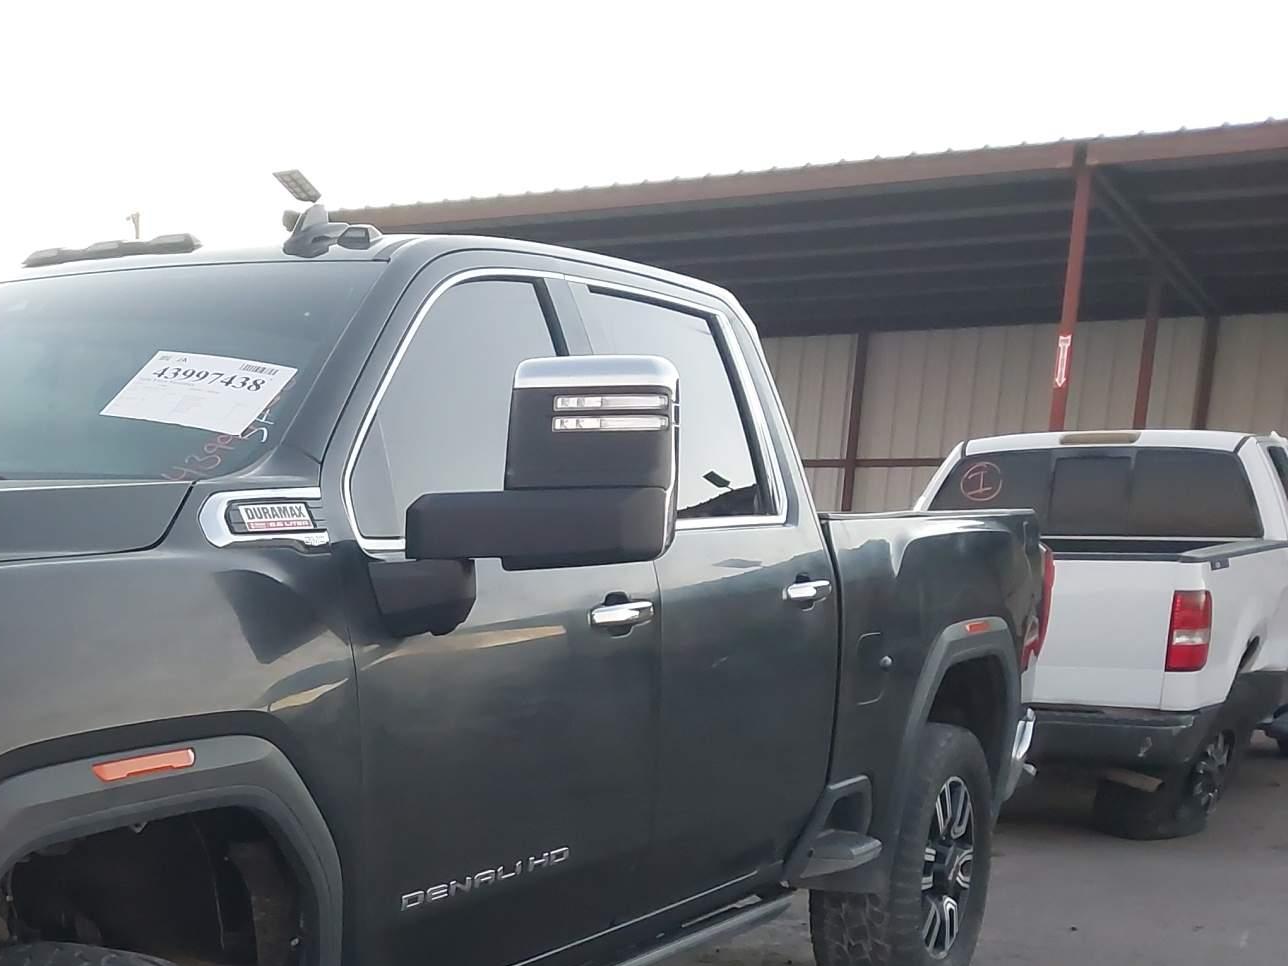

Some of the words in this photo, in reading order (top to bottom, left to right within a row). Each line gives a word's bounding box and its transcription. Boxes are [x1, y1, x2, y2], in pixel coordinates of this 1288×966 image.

[152, 366, 266, 392] 43997438
[244, 505, 306, 520] DURAMAX
[400, 861, 522, 911] DENALI
[528, 847, 569, 872] HD
